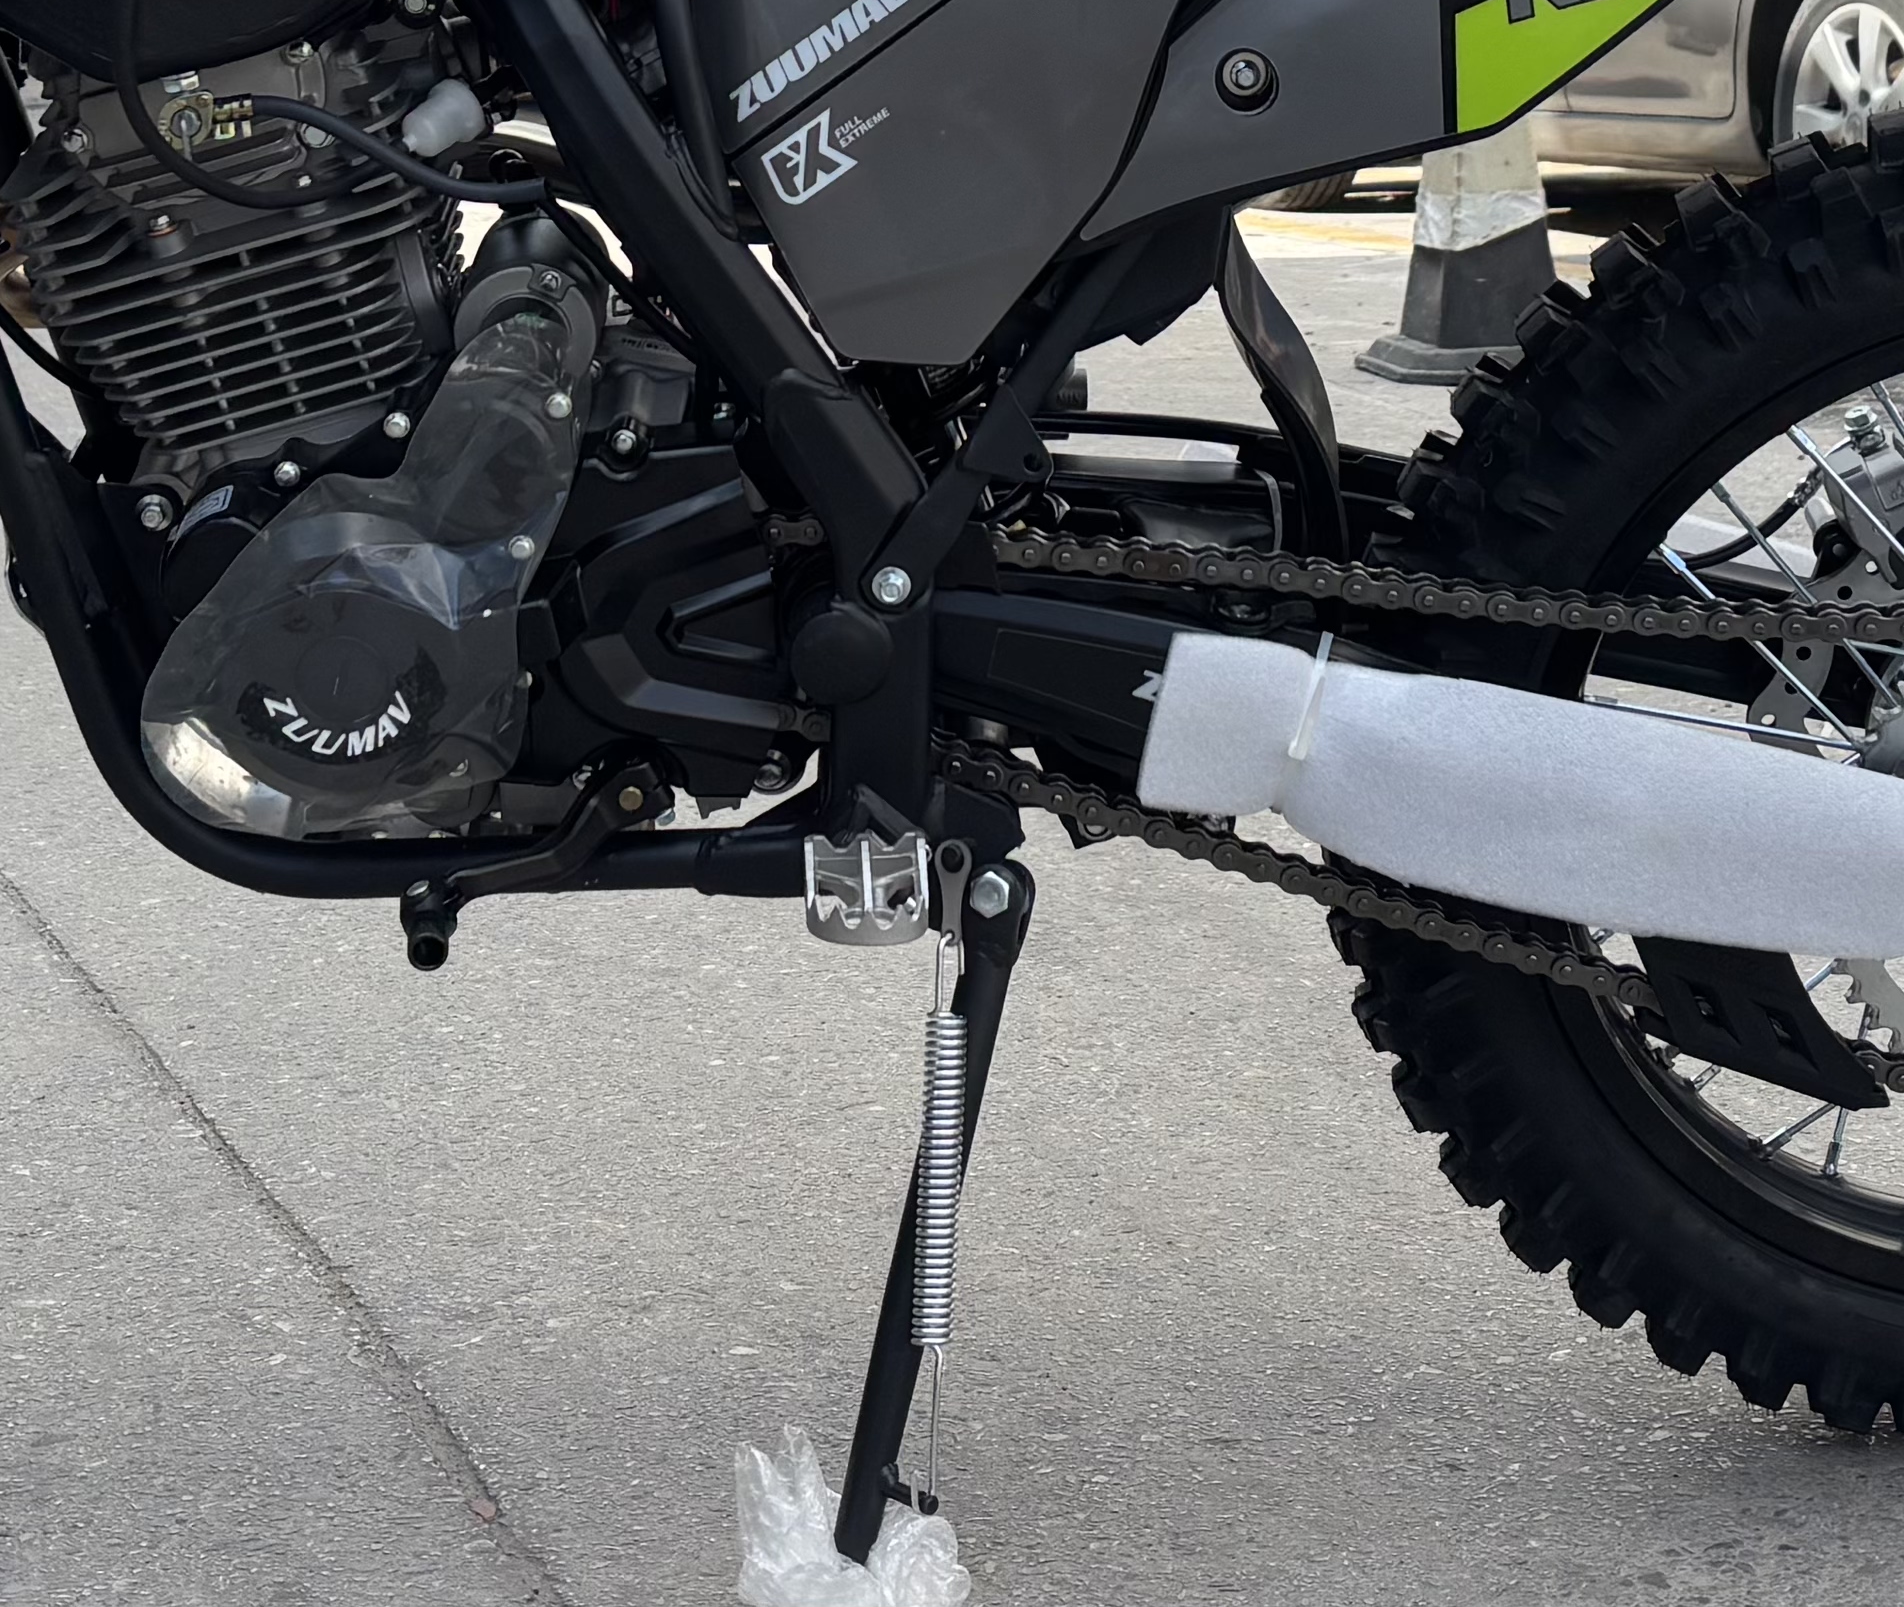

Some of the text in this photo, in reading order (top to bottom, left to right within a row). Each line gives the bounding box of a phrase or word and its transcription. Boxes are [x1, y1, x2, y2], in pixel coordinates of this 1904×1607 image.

[834, 115, 864, 140] FULL
[839, 107, 891, 149] EXTREME
[263, 690, 412, 757] ZUUMAV
